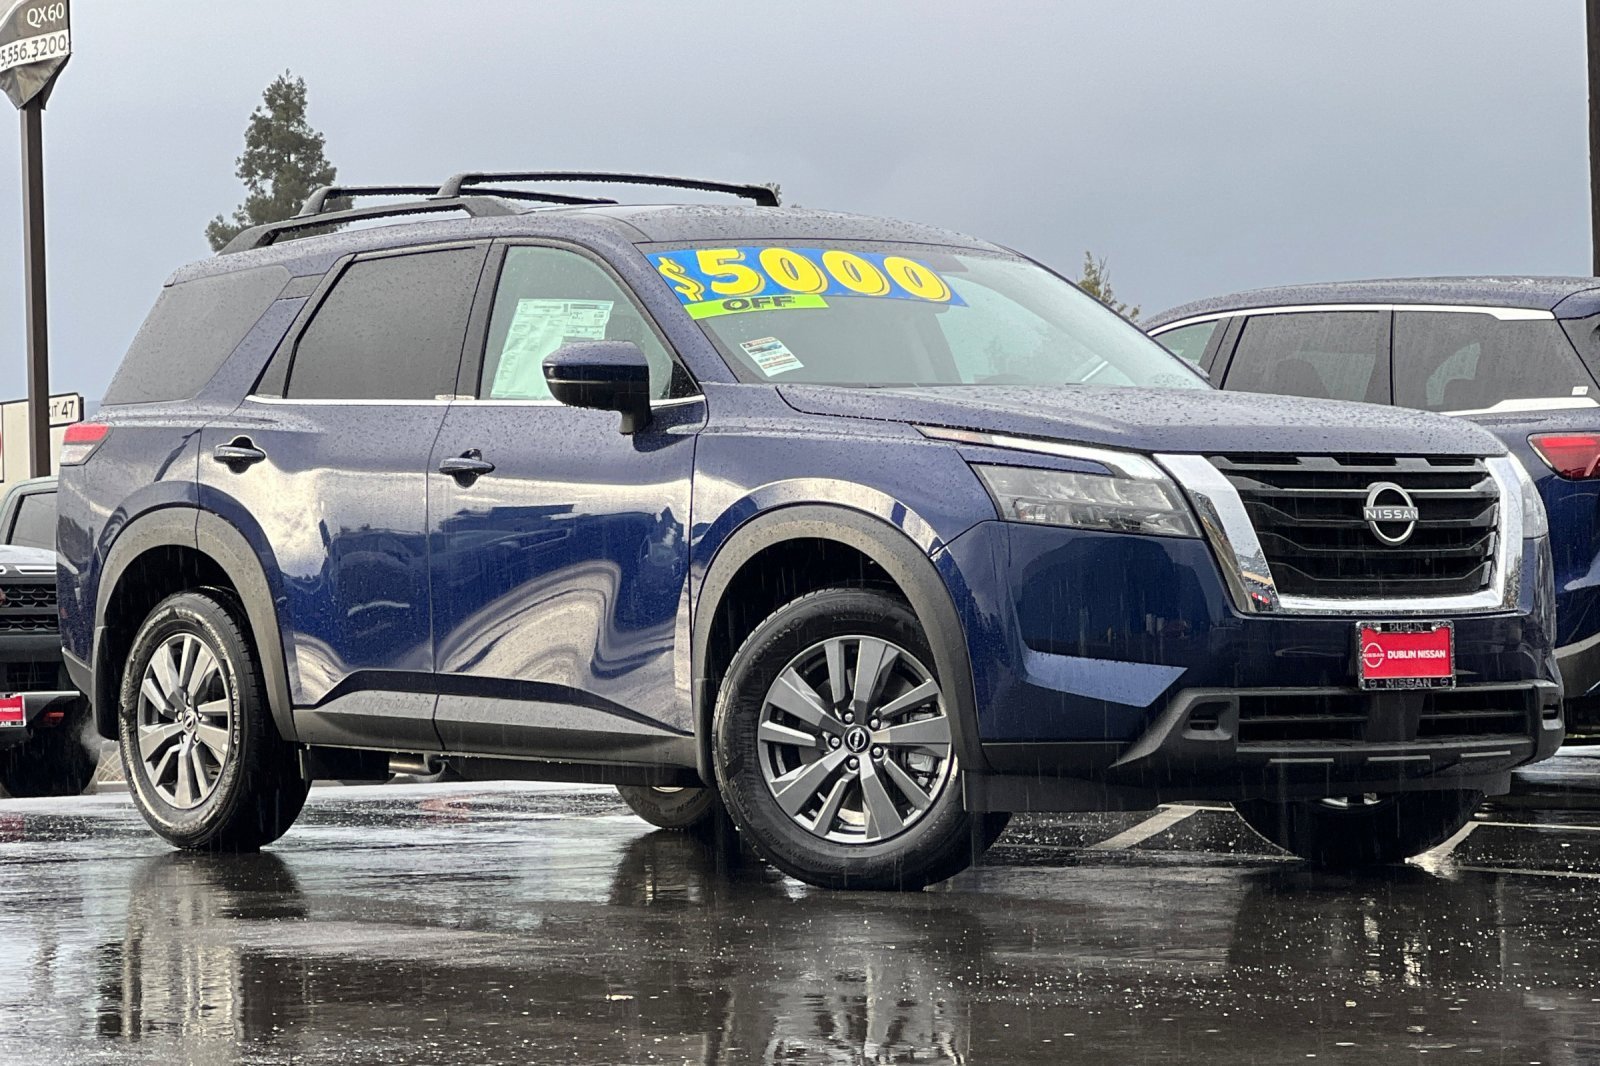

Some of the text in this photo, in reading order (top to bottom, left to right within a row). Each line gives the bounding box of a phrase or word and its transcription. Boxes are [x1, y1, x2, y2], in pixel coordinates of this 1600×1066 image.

[27, 2, 64, 28] QX60
[0, 34, 67, 67] 5.556.3200
[722, 296, 796, 312] OFF
[61, 400, 75, 418] 47
[1366, 509, 1418, 519] NISSAN
[1389, 623, 1424, 632] DUBLIN
[1387, 650, 1446, 659] DUBLIN NISSAN
[1385, 679, 1432, 688] NISSAN
